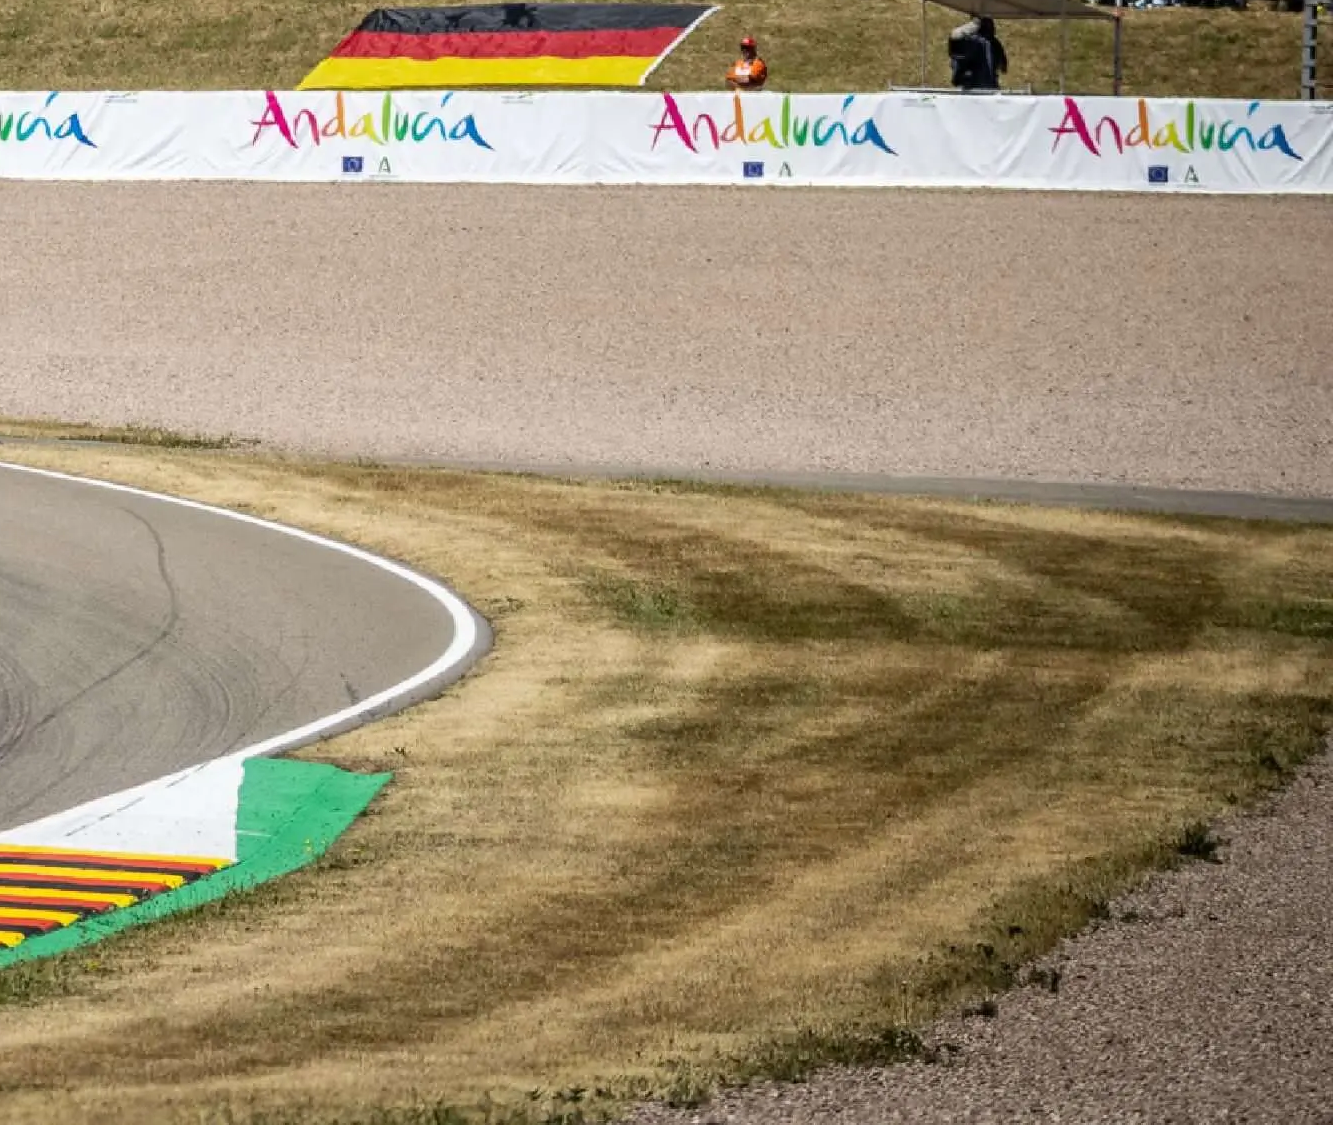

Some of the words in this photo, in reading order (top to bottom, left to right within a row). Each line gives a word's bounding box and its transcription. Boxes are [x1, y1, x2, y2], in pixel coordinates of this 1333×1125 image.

[252, 90, 496, 150] Andalucía
[650, 93, 898, 156] Andalucía
[1048, 97, 1303, 161] Andalucía
